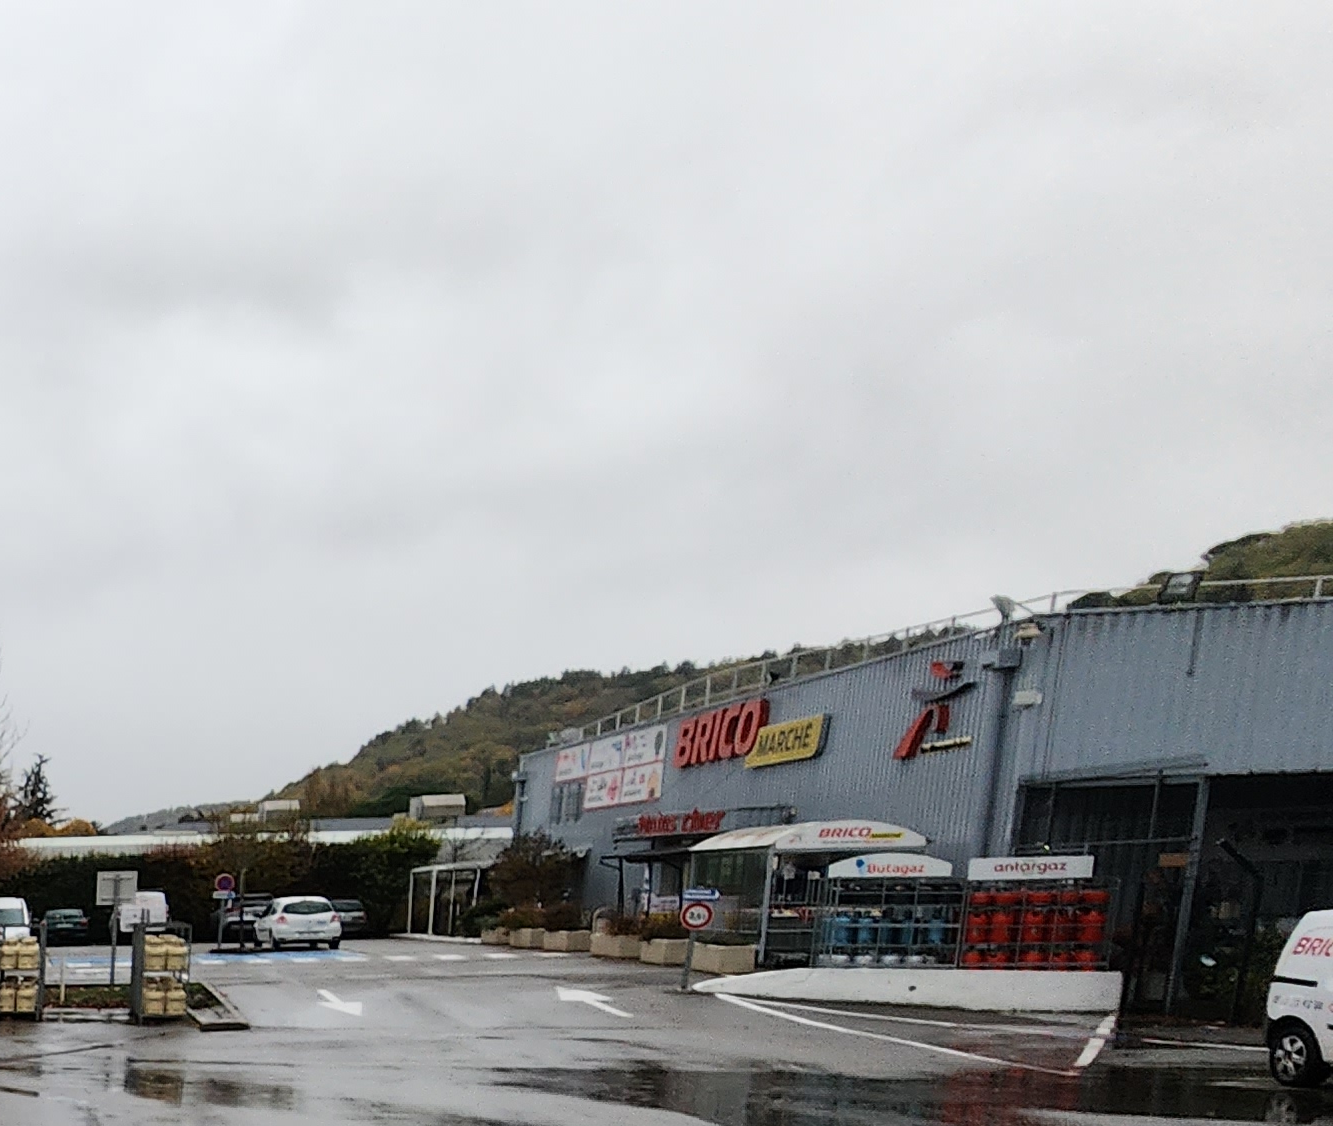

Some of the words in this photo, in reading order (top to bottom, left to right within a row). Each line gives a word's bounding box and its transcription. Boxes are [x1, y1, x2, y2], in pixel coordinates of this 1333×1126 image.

[673, 700, 763, 768] BRICO
[818, 826, 872, 838] BRICO
[866, 863, 925, 876] Butagaz
[994, 861, 1067, 874] antargaz
